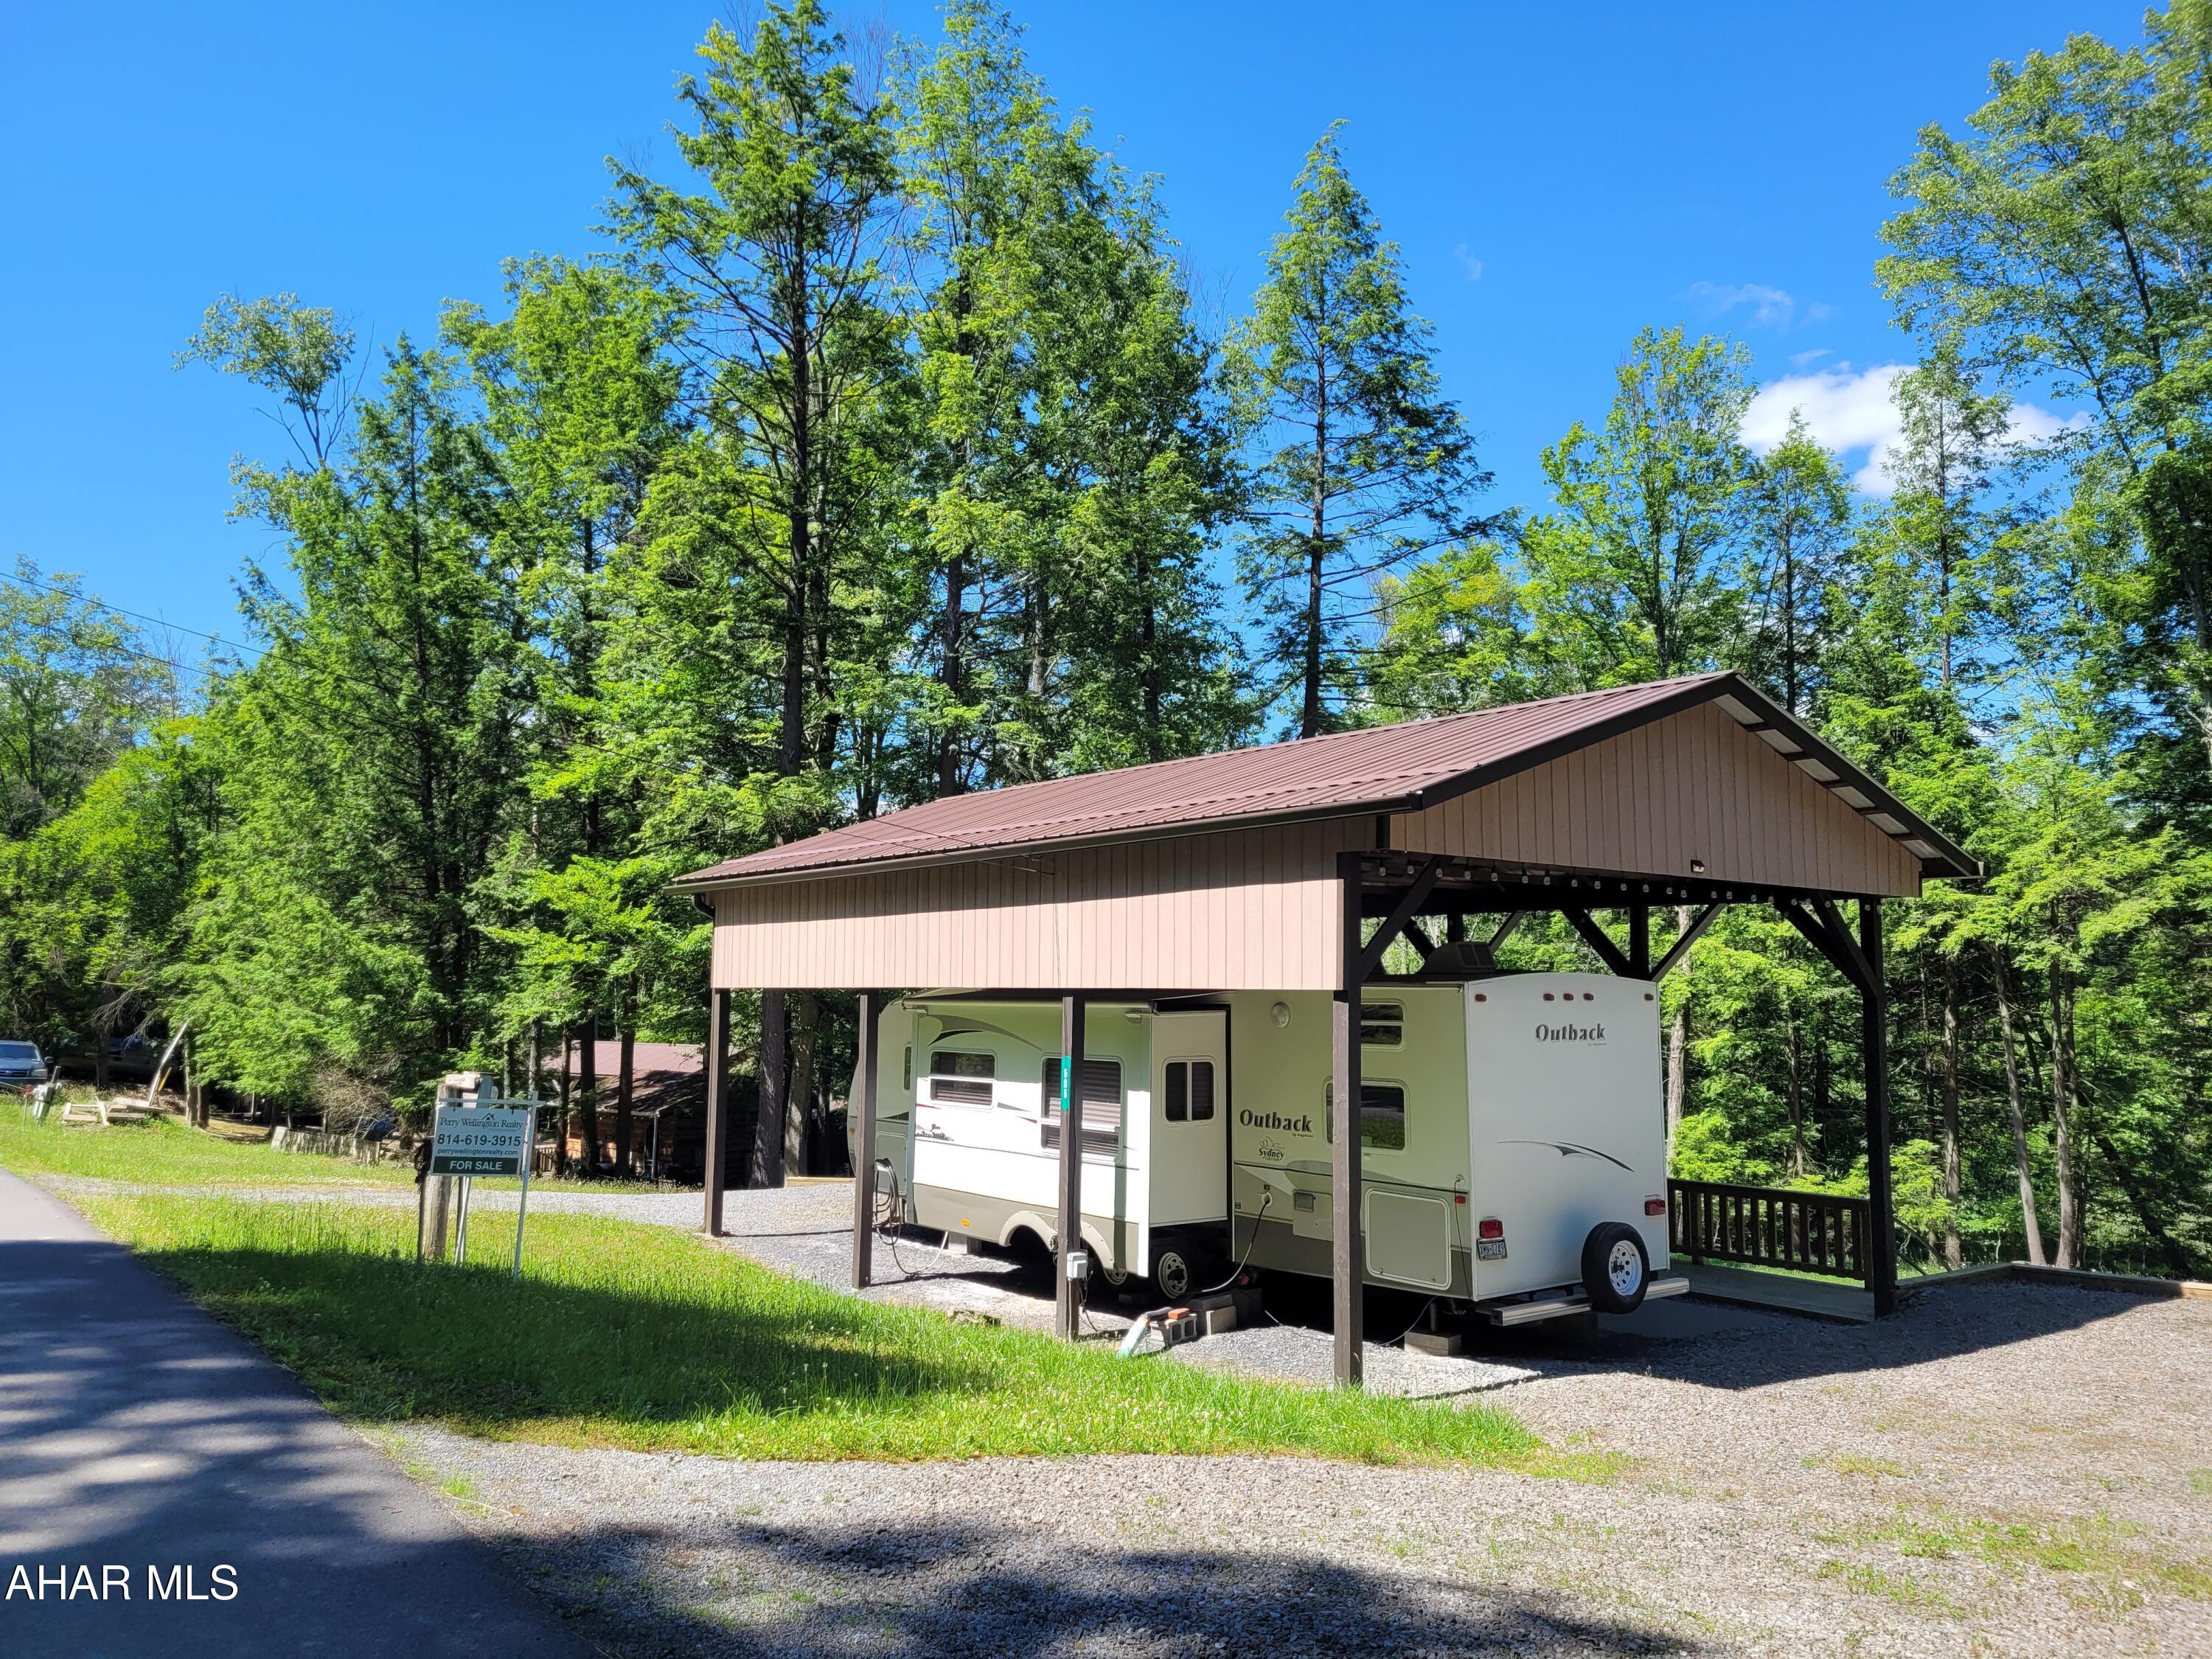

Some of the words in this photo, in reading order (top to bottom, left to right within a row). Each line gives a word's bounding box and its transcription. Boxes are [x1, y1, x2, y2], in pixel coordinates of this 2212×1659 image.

[1536, 1023, 1606, 1041] Outback
[440, 1117, 460, 1128] Perry
[462, 1118, 499, 1129] Wellington
[501, 1119, 524, 1130] Realty
[1239, 1109, 1312, 1132] Outback
[437, 1133, 521, 1147] 814-619-3915
[437, 1148, 518, 1156] perrywellingtonrealty.com
[1259, 1147, 1285, 1161] Sydney
[450, 1161, 472, 1171] FOR
[475, 1161, 503, 1171] SALE
